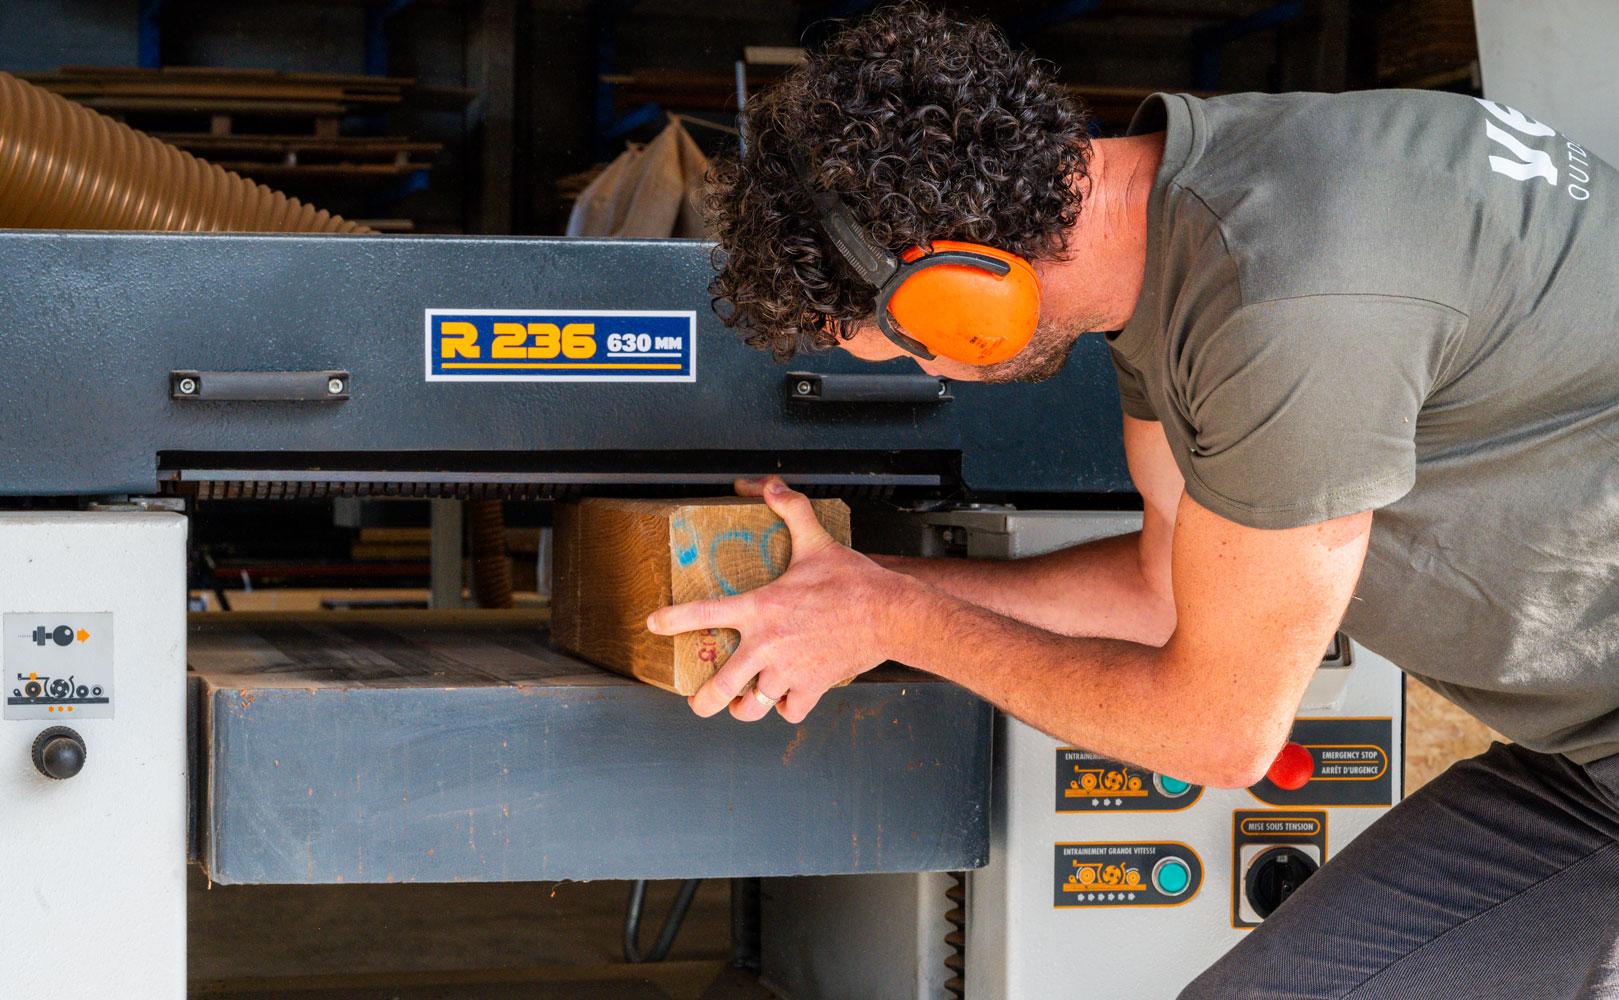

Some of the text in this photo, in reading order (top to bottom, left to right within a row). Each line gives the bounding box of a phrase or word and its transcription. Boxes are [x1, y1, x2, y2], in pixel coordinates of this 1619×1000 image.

[1564, 137, 1590, 201] OUTD
[441, 321, 682, 359] R 236 630 MM
[1322, 751, 1378, 759] EMERGENCY STOP
[1321, 765, 1379, 774] ARRÊT D'URGENCE
[1248, 822, 1314, 831] MISE SOUS TENSION
[1063, 847, 1156, 856] ENTRAINEMENT GRANDE VITESSE
